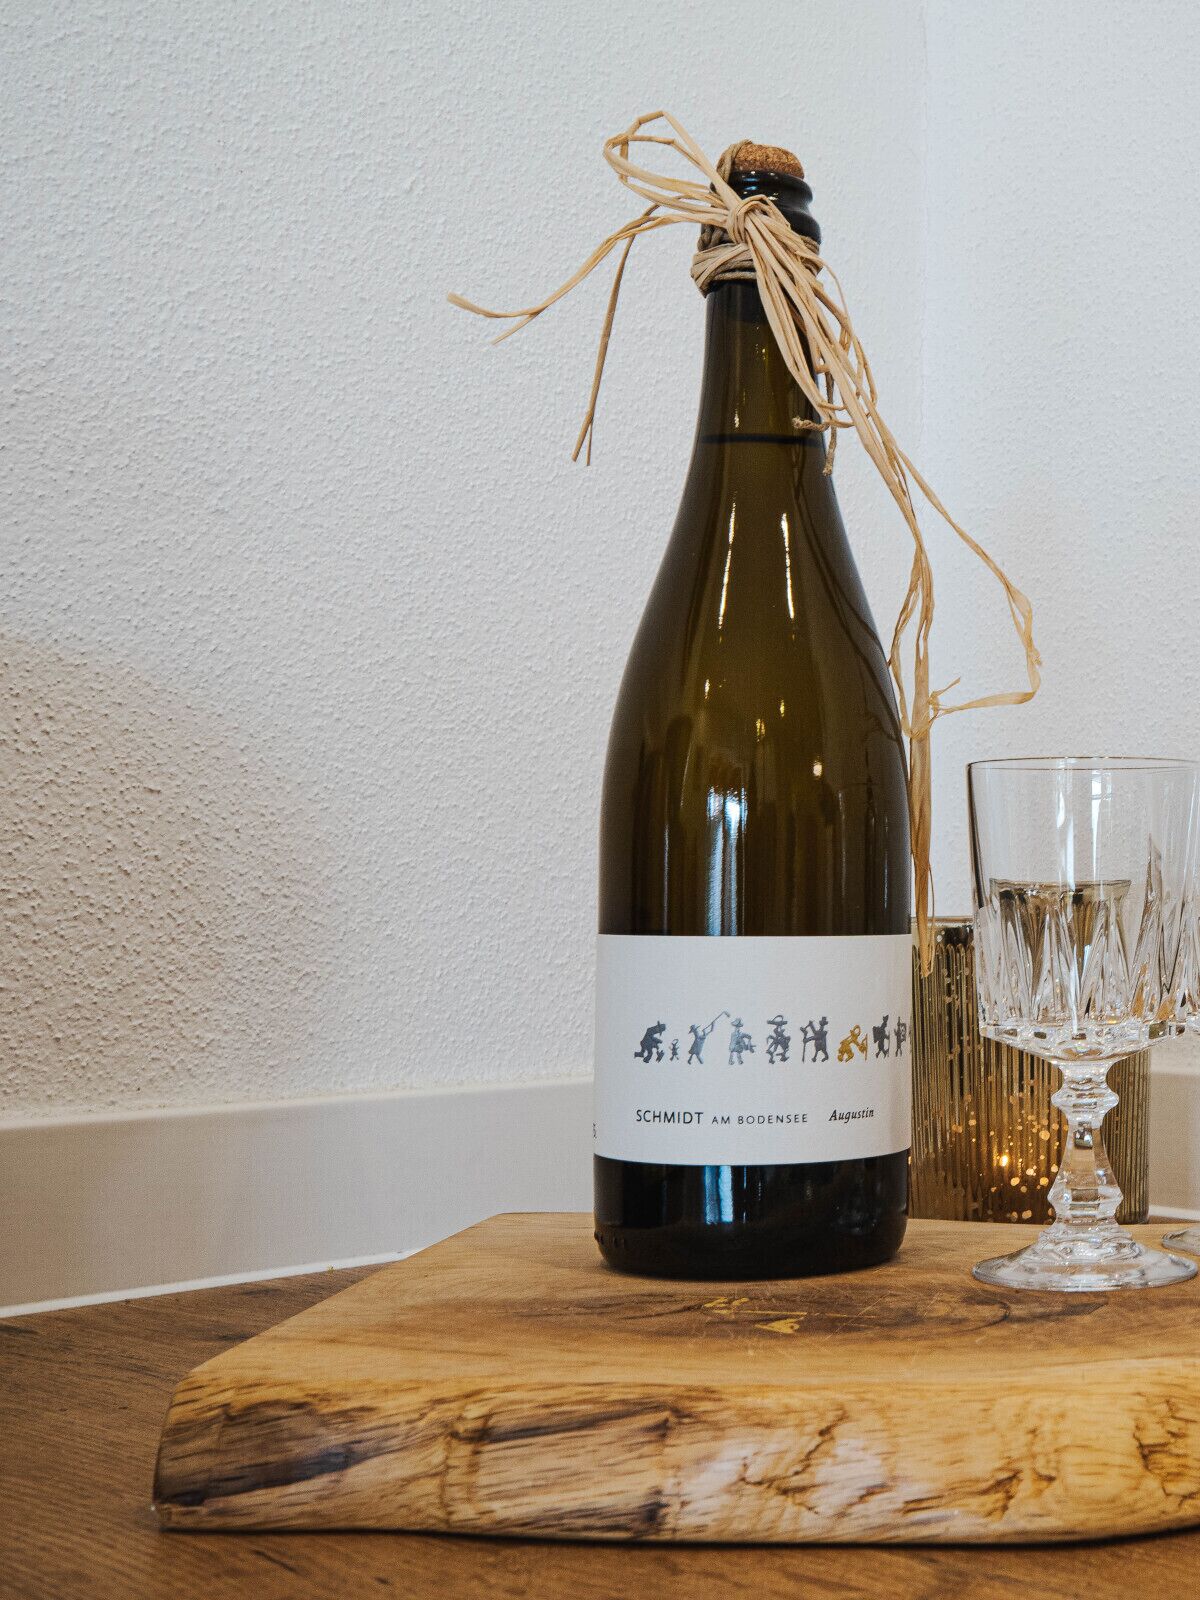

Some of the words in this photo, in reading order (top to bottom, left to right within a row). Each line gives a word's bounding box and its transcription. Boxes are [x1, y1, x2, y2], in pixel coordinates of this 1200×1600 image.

[635, 1108, 704, 1125] SCHMIDT
[711, 1116, 731, 1125] AM
[737, 1113, 809, 1125] BODENSEE
[828, 1107, 875, 1123] Augustin
